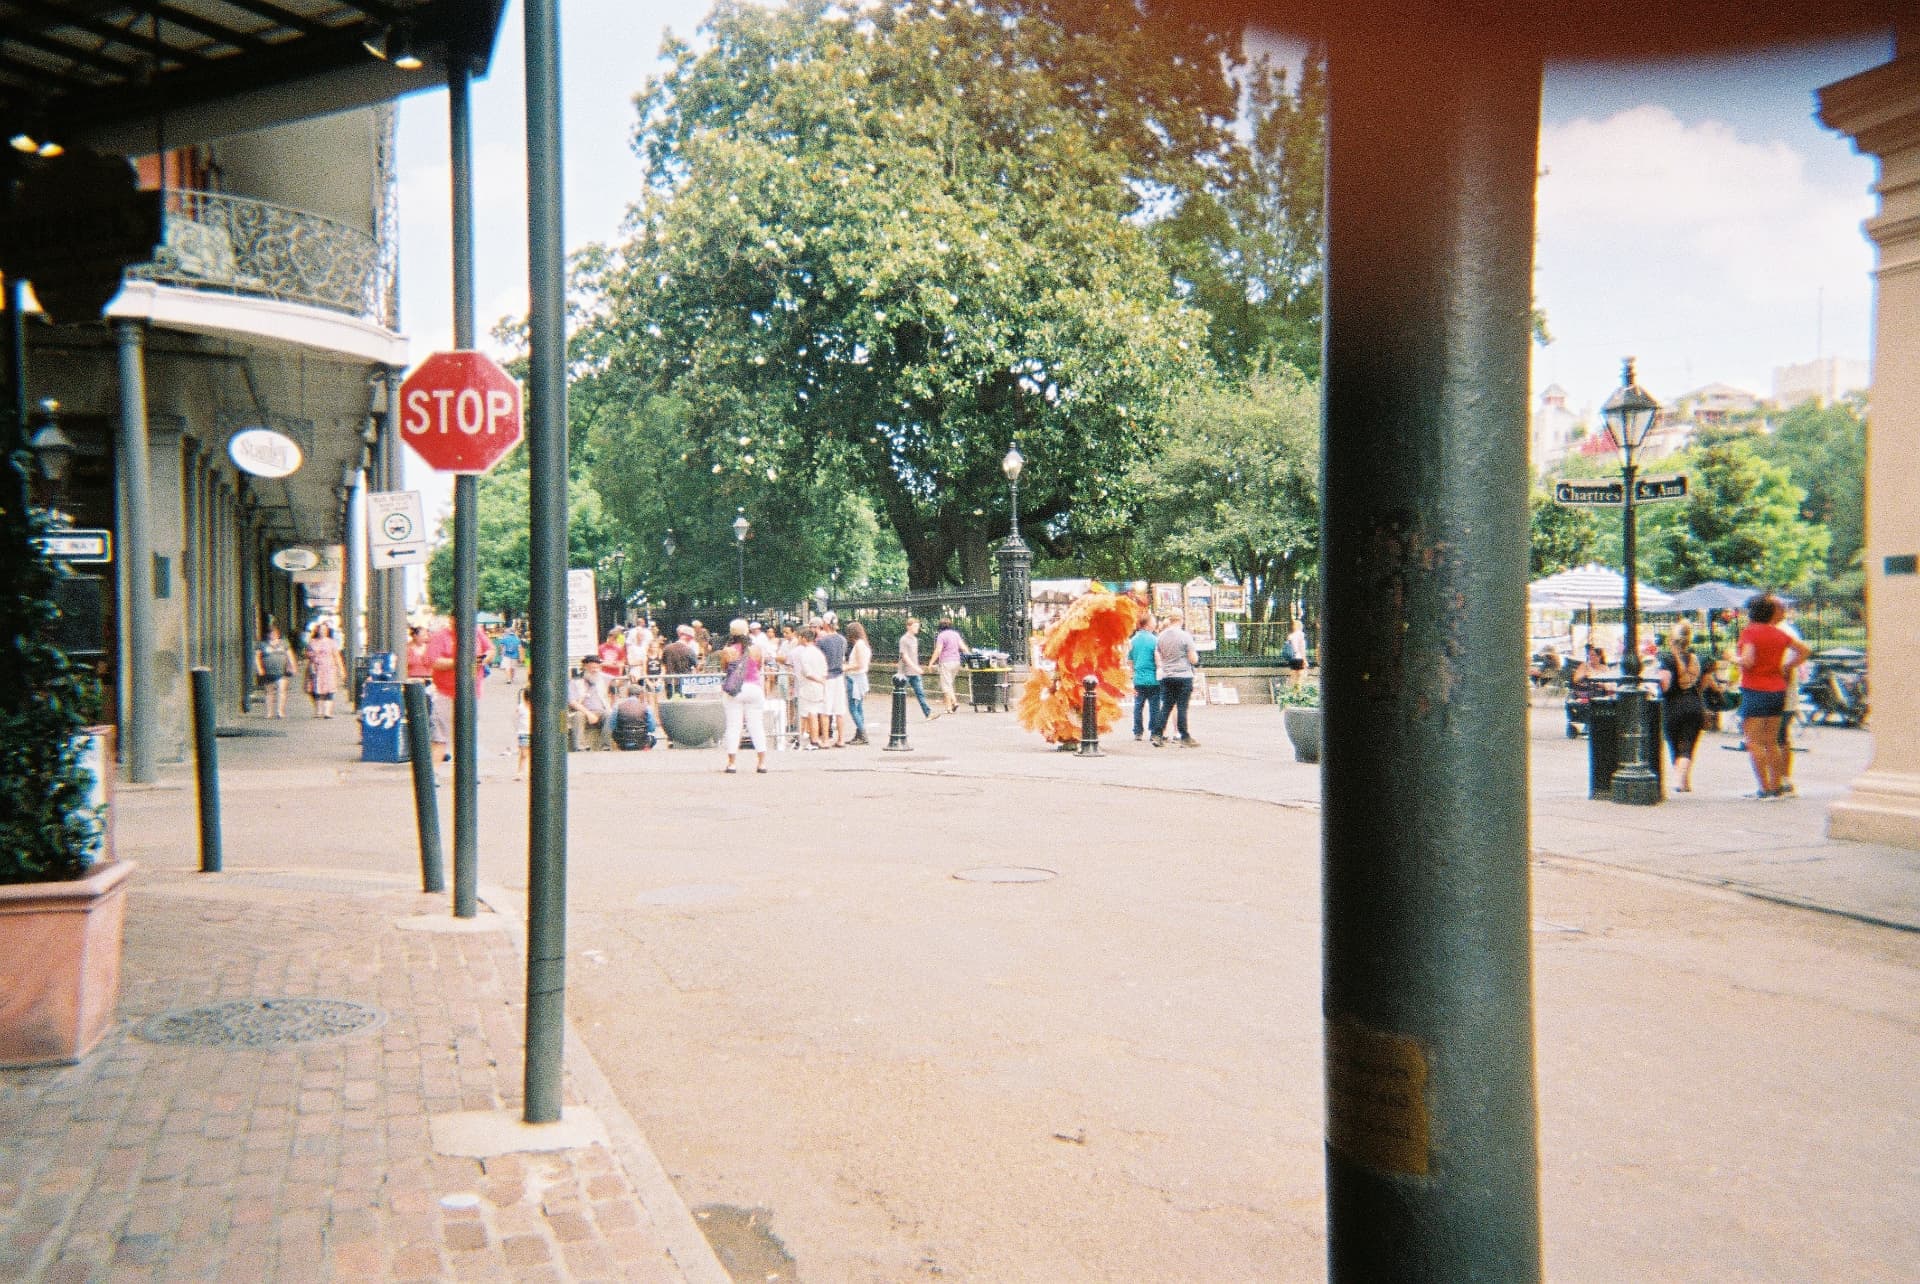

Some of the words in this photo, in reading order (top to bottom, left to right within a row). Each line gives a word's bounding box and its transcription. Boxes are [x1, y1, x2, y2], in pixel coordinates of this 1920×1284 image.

[406, 389, 513, 435] STOP
[1559, 487, 1620, 501] Chartres
[1658, 484, 1681, 496] Ann
